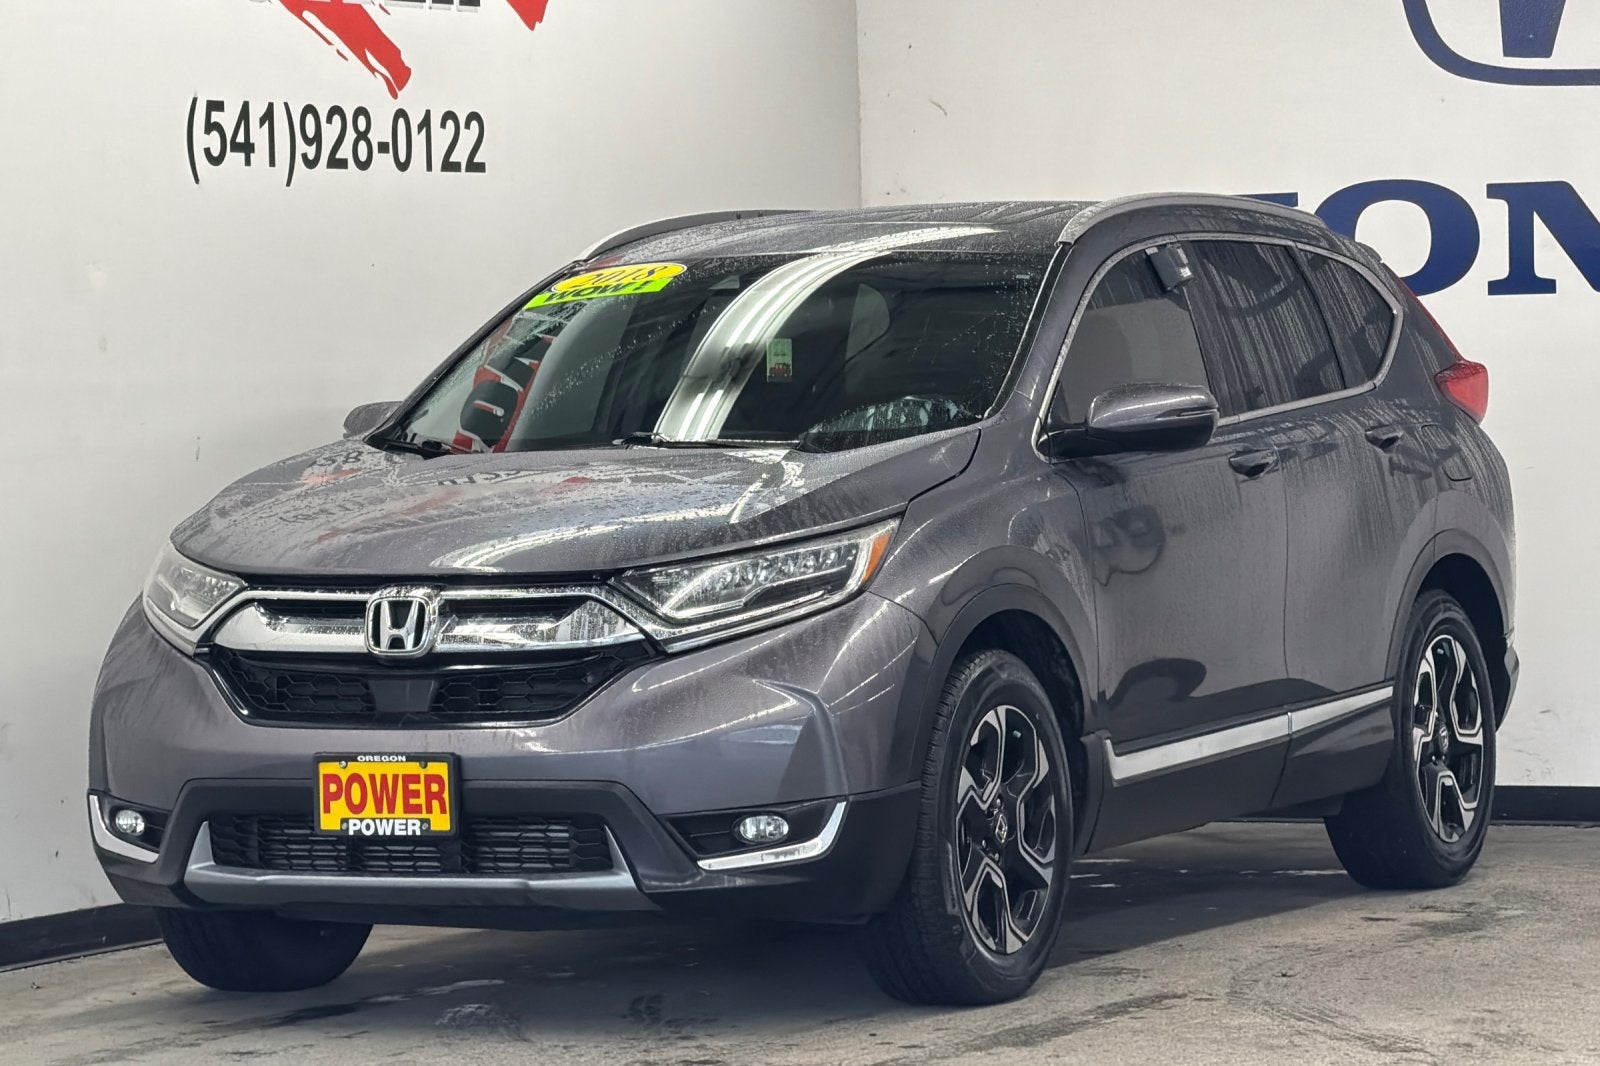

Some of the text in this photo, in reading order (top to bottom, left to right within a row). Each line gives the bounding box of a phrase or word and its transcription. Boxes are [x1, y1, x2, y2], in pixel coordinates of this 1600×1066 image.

[187, 96, 486, 187] (541)928-0122
[322, 772, 448, 815] POWER
[348, 818, 421, 836] POWER
